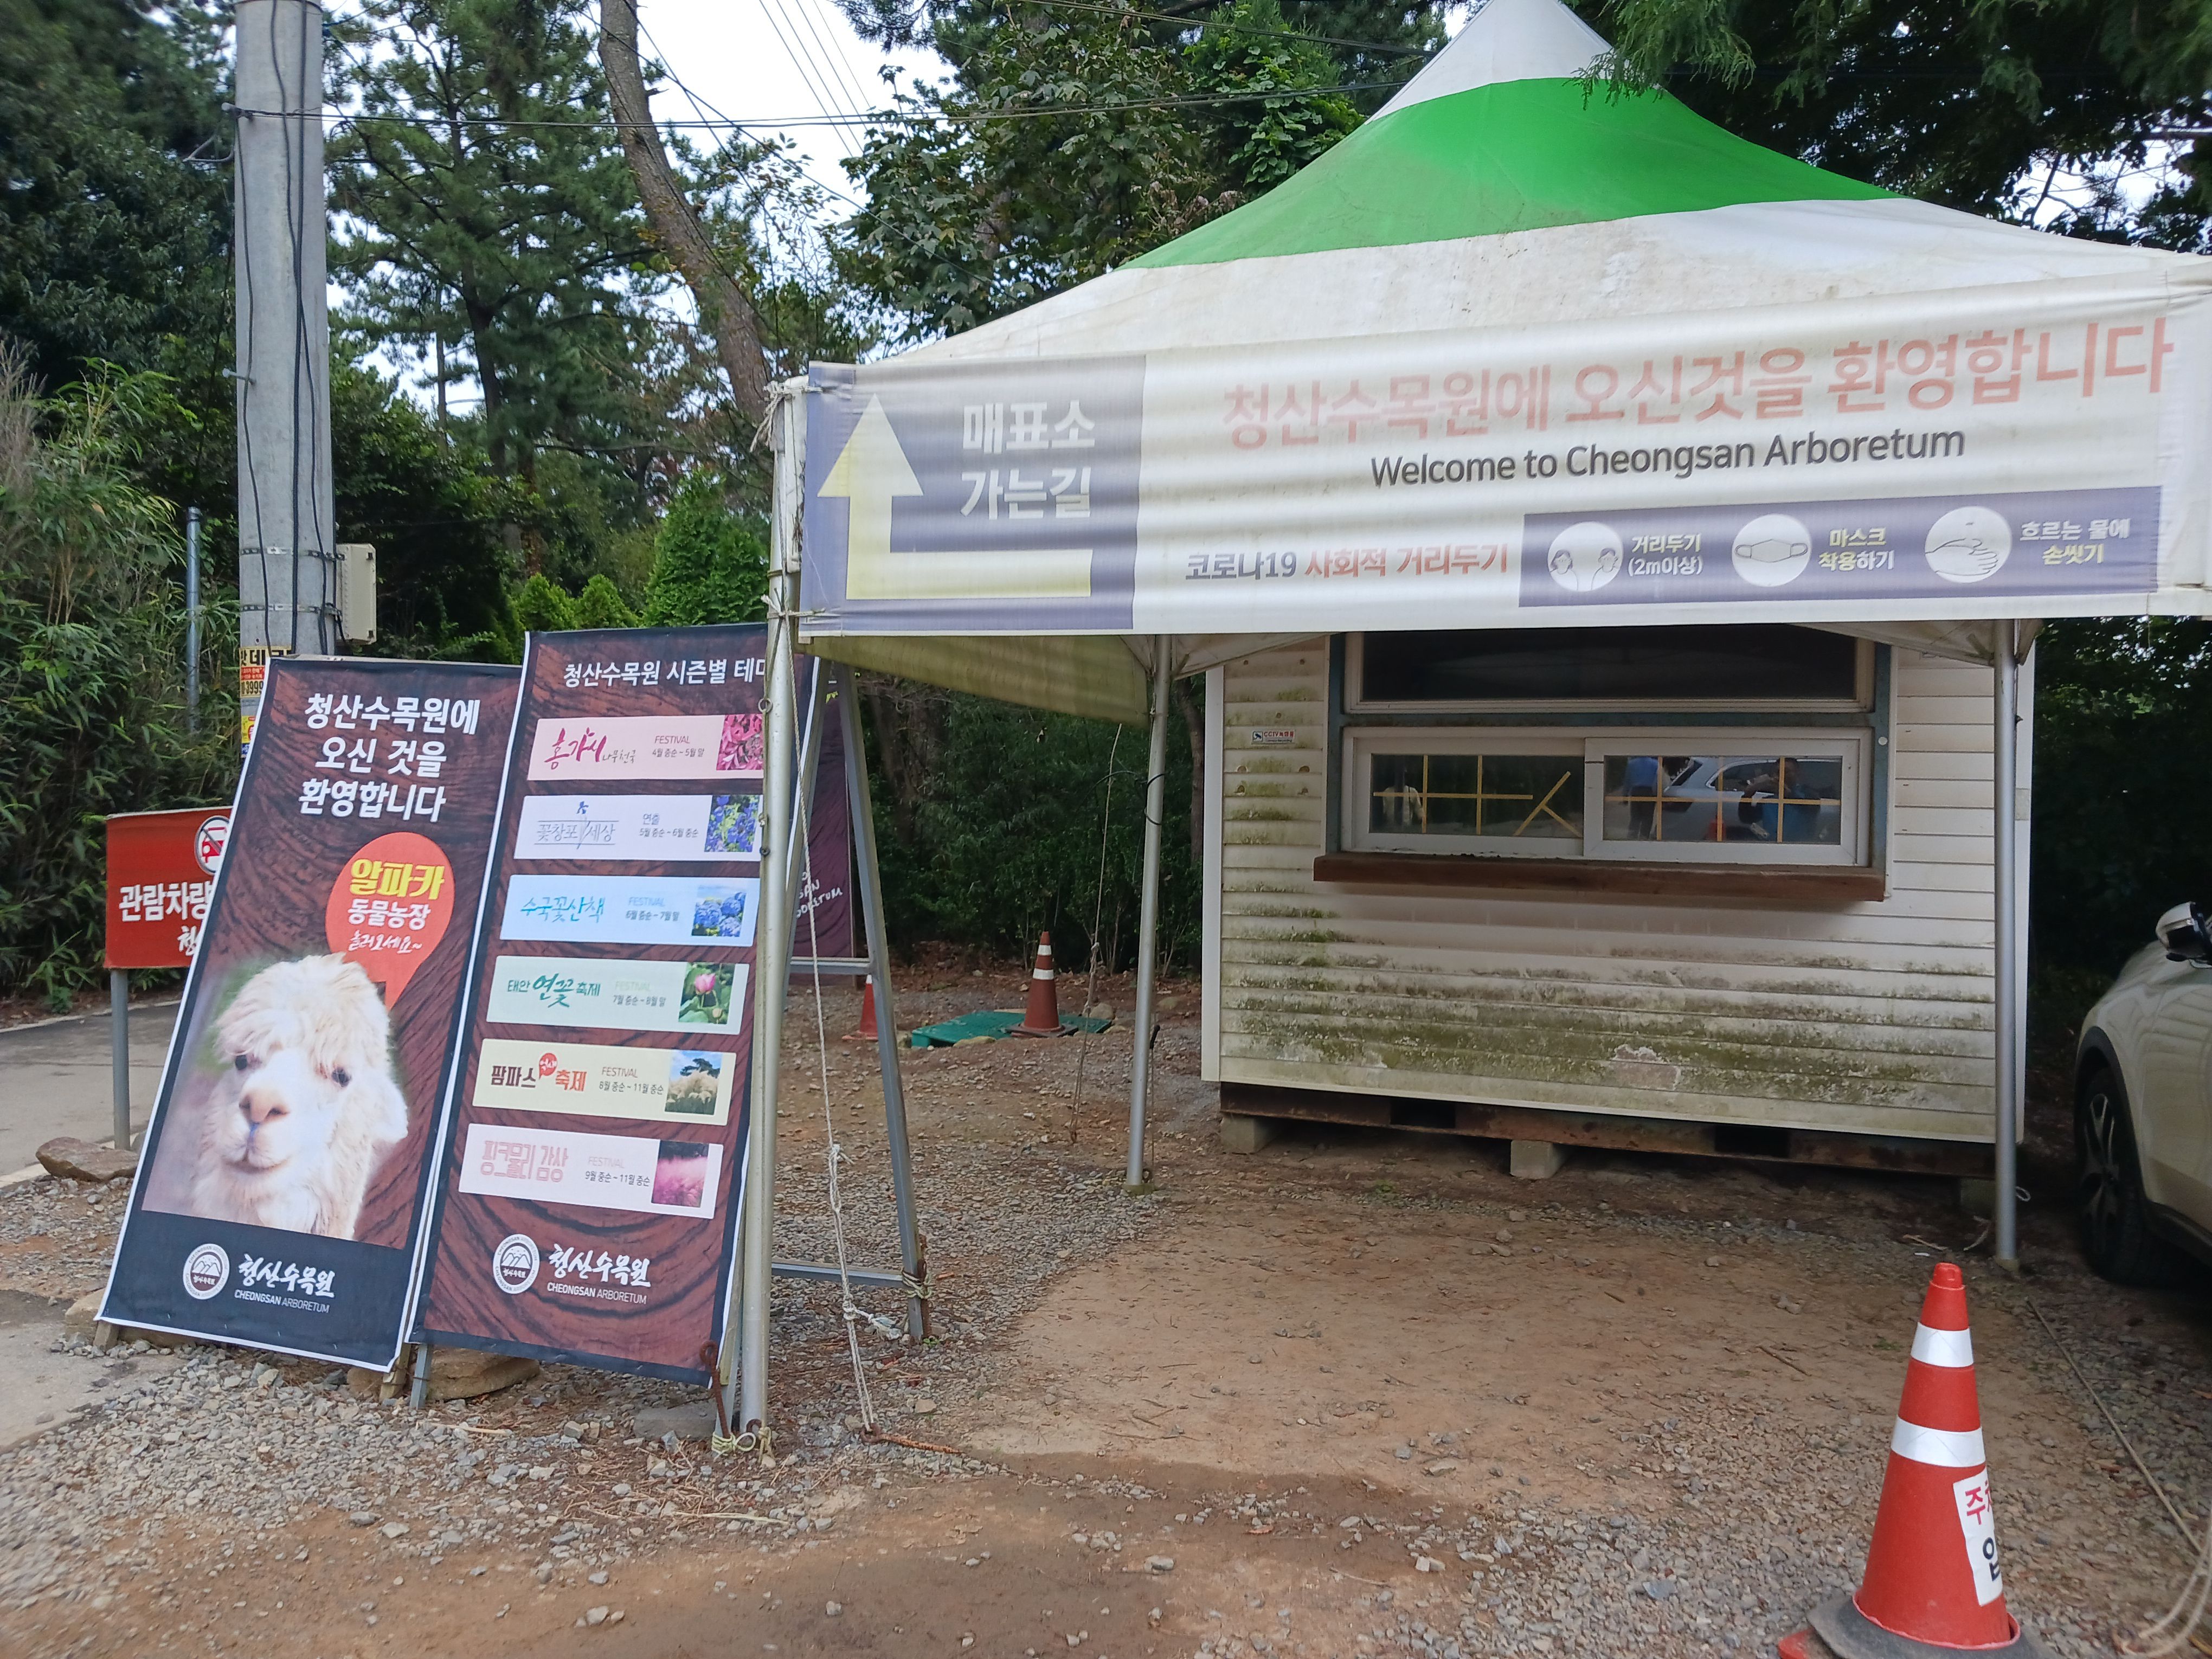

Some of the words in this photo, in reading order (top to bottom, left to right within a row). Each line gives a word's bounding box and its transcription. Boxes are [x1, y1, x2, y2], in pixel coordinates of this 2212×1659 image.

[1223, 364, 1551, 450] 청산수목원에
[1565, 347, 1811, 425] 오신것을
[1828, 317, 2175, 414] 환영합니다
[962, 400, 1096, 454] 매표소
[1371, 453, 1516, 488] Welcome
[1523, 450, 1558, 478] to
[1565, 441, 1755, 479] Cheongsan
[1763, 428, 1965, 467] Arboretum
[960, 467, 1092, 520] 가는길
[1631, 533, 1701, 554] 거리두기
[1829, 527, 1887, 547] 마스크
[2020, 520, 2083, 542] 흐르는
[2088, 518, 2130, 539] 물에
[1185, 551, 1297, 581] 코로나19
[1304, 547, 1387, 579] 사회적
[1396, 543, 1508, 576] 거리두기
[1628, 555, 1703, 577] (2m이상)
[1817, 549, 1895, 573] 착용하기
[2042, 544, 2105, 566] 손씻기
[563, 659, 661, 688] 청산수목원
[666, 658, 728, 685] 시즌별
[305, 693, 481, 735] 청산수목원에
[544, 727, 607, 770] 홍가시
[654, 735, 690, 744] FESTIVAL
[314, 736, 377, 773] 오신
[388, 740, 447, 778] 것을
[298, 777, 447, 822] 환영합니다
[349, 858, 445, 900] 알파카
[118, 880, 214, 922] 관람차량
[348, 898, 432, 930] 동물농장
[520, 896, 605, 923] 수국꽃산책
[532, 973, 575, 1008] 연꽃
[575, 981, 601, 996] 축제
[491, 1065, 536, 1088] 팜파스
[555, 1069, 587, 1092] 축제
[601, 1066, 638, 1078] FESTIVAL
[612, 1082, 625, 1092] 중순
[634, 1083, 649, 1094] 11월
[650, 1084, 664, 1095] 중순
[536, 1145, 569, 1183] 감상
[588, 1156, 625, 1169] FESTIVAL
[585, 1171, 597, 1182] 9월
[598, 1172, 612, 1183] 중순
[620, 1174, 635, 1185] 11월
[636, 1175, 651, 1187] 중순
[238, 1253, 336, 1298] 청산수목원
[548, 1243, 652, 1288] 청산수목원
[234, 1289, 281, 1306] CHEONGSAN
[281, 1297, 330, 1313] ARBORETUM
[546, 1282, 596, 1298] CHEONGSAN
[596, 1289, 647, 1305] ARBORETUM
